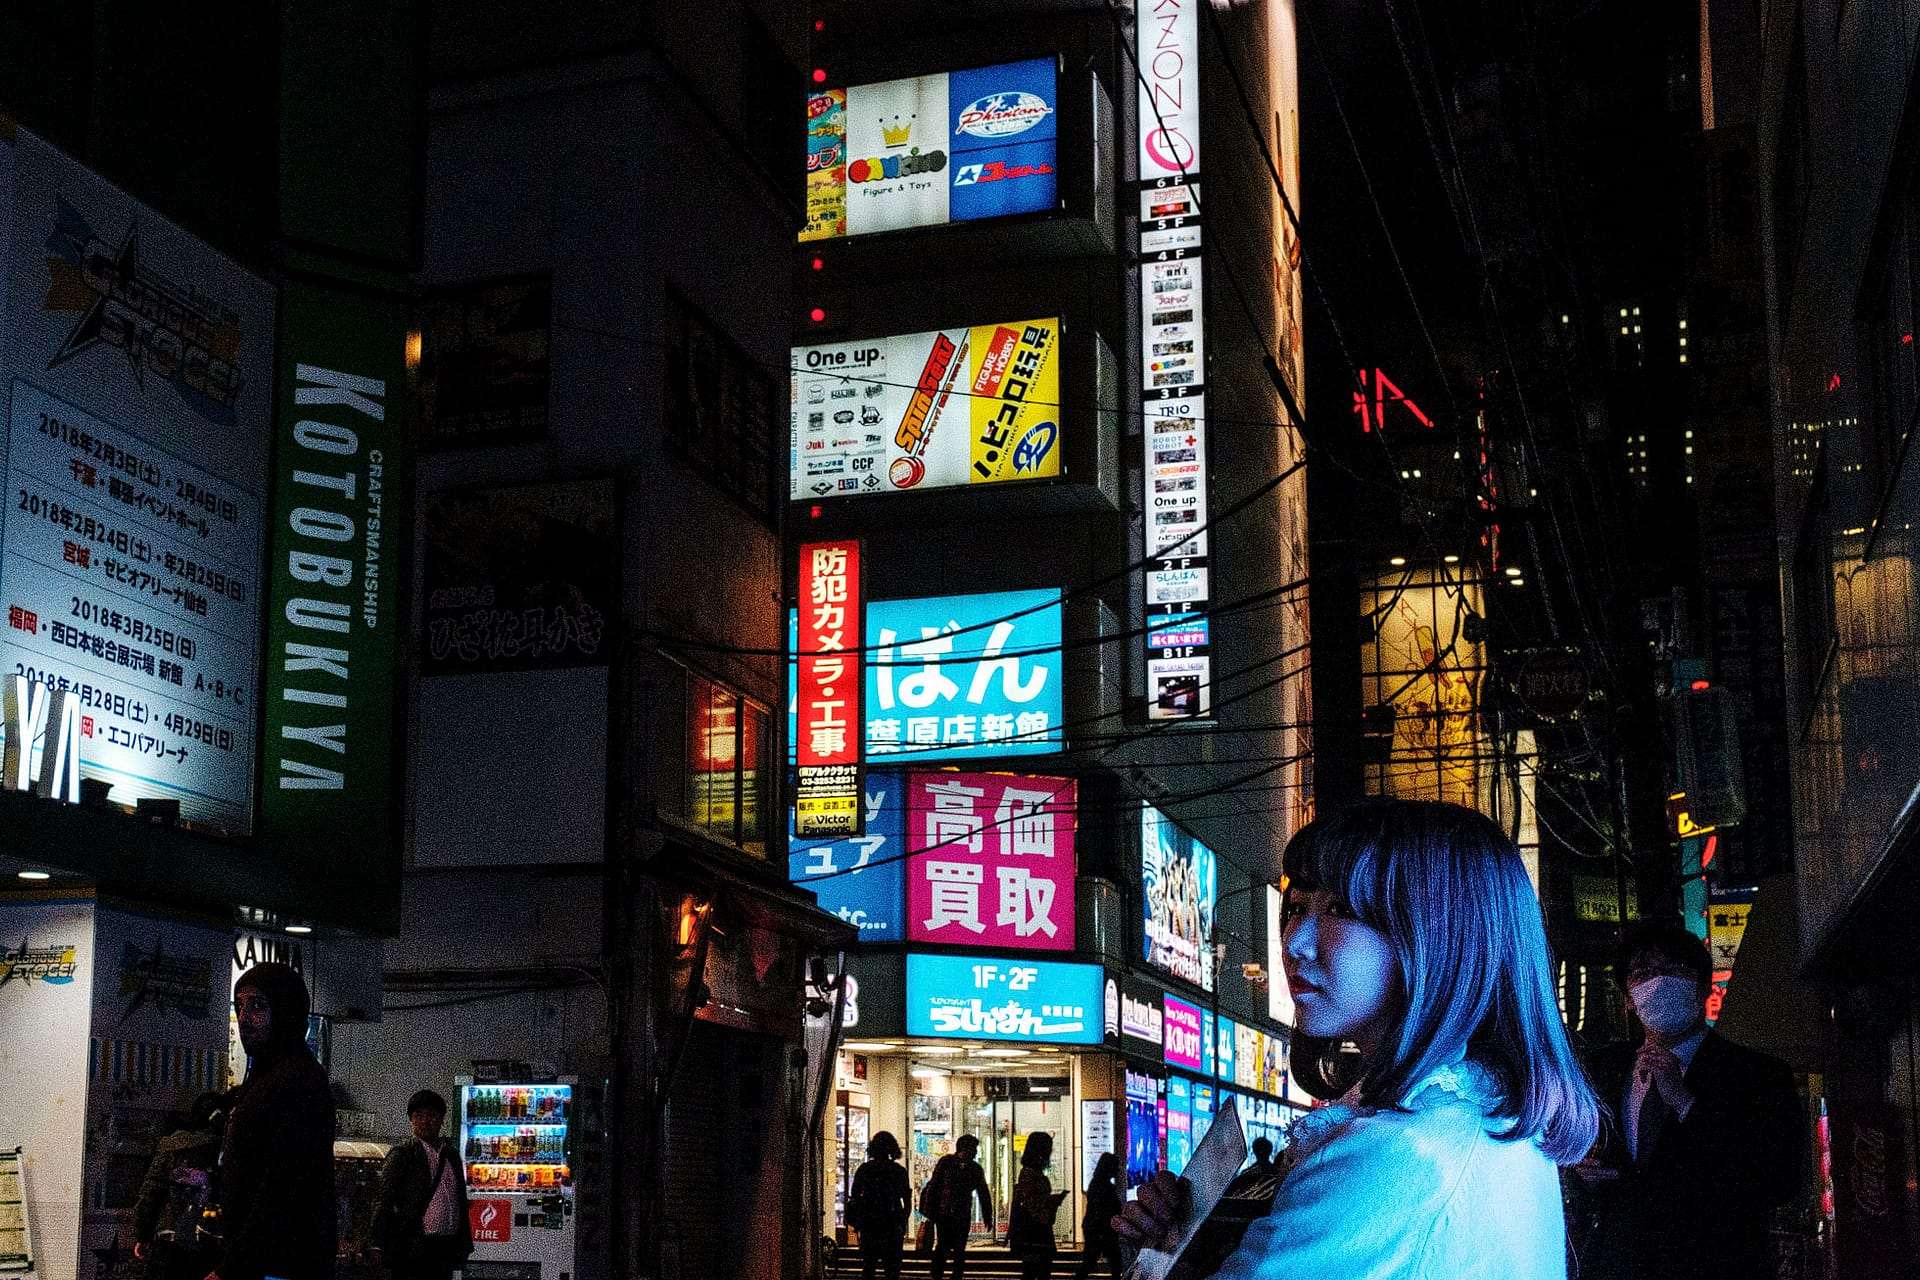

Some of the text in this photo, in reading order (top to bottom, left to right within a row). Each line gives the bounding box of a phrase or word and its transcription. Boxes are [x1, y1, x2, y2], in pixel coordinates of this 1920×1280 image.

[956, 104, 1053, 134] Phantom
[863, 182, 932, 198] Figure & Toys
[806, 350, 846, 368] One
[854, 348, 885, 367] up.
[990, 335, 1017, 384] & HOBBY
[974, 351, 998, 392] FIGURE
[1159, 404, 1190, 417] TRIO
[1153, 436, 1182, 444] ROBOT
[1153, 443, 1182, 451] ROBOT
[852, 457, 874, 471] CCP
[1154, 497, 1178, 507] One
[363, 448, 384, 630] CRAFTSMANSHIP
[278, 361, 387, 790] KOTOBUKIYA
[71, 596, 199, 661] 2018年3月25日(日)
[8, 604, 155, 677] 福岡・西日本総合展示場
[158, 658, 184, 687] 新館
[809, 548, 848, 757] 防犯カメラ・工事
[1163, 647, 1194, 659] B1F
[80, 714, 189, 765] 岡・エコパアリーナ
[867, 710, 1049, 755] 葉原店新館
[803, 824, 851, 835] Panasonic
[816, 814, 851, 825] Victor
[925, 780, 1056, 858] 高価
[923, 860, 1058, 939] 買取
[1714, 912, 1745, 927] 富士
[474, 1229, 499, 1240] FIRE
